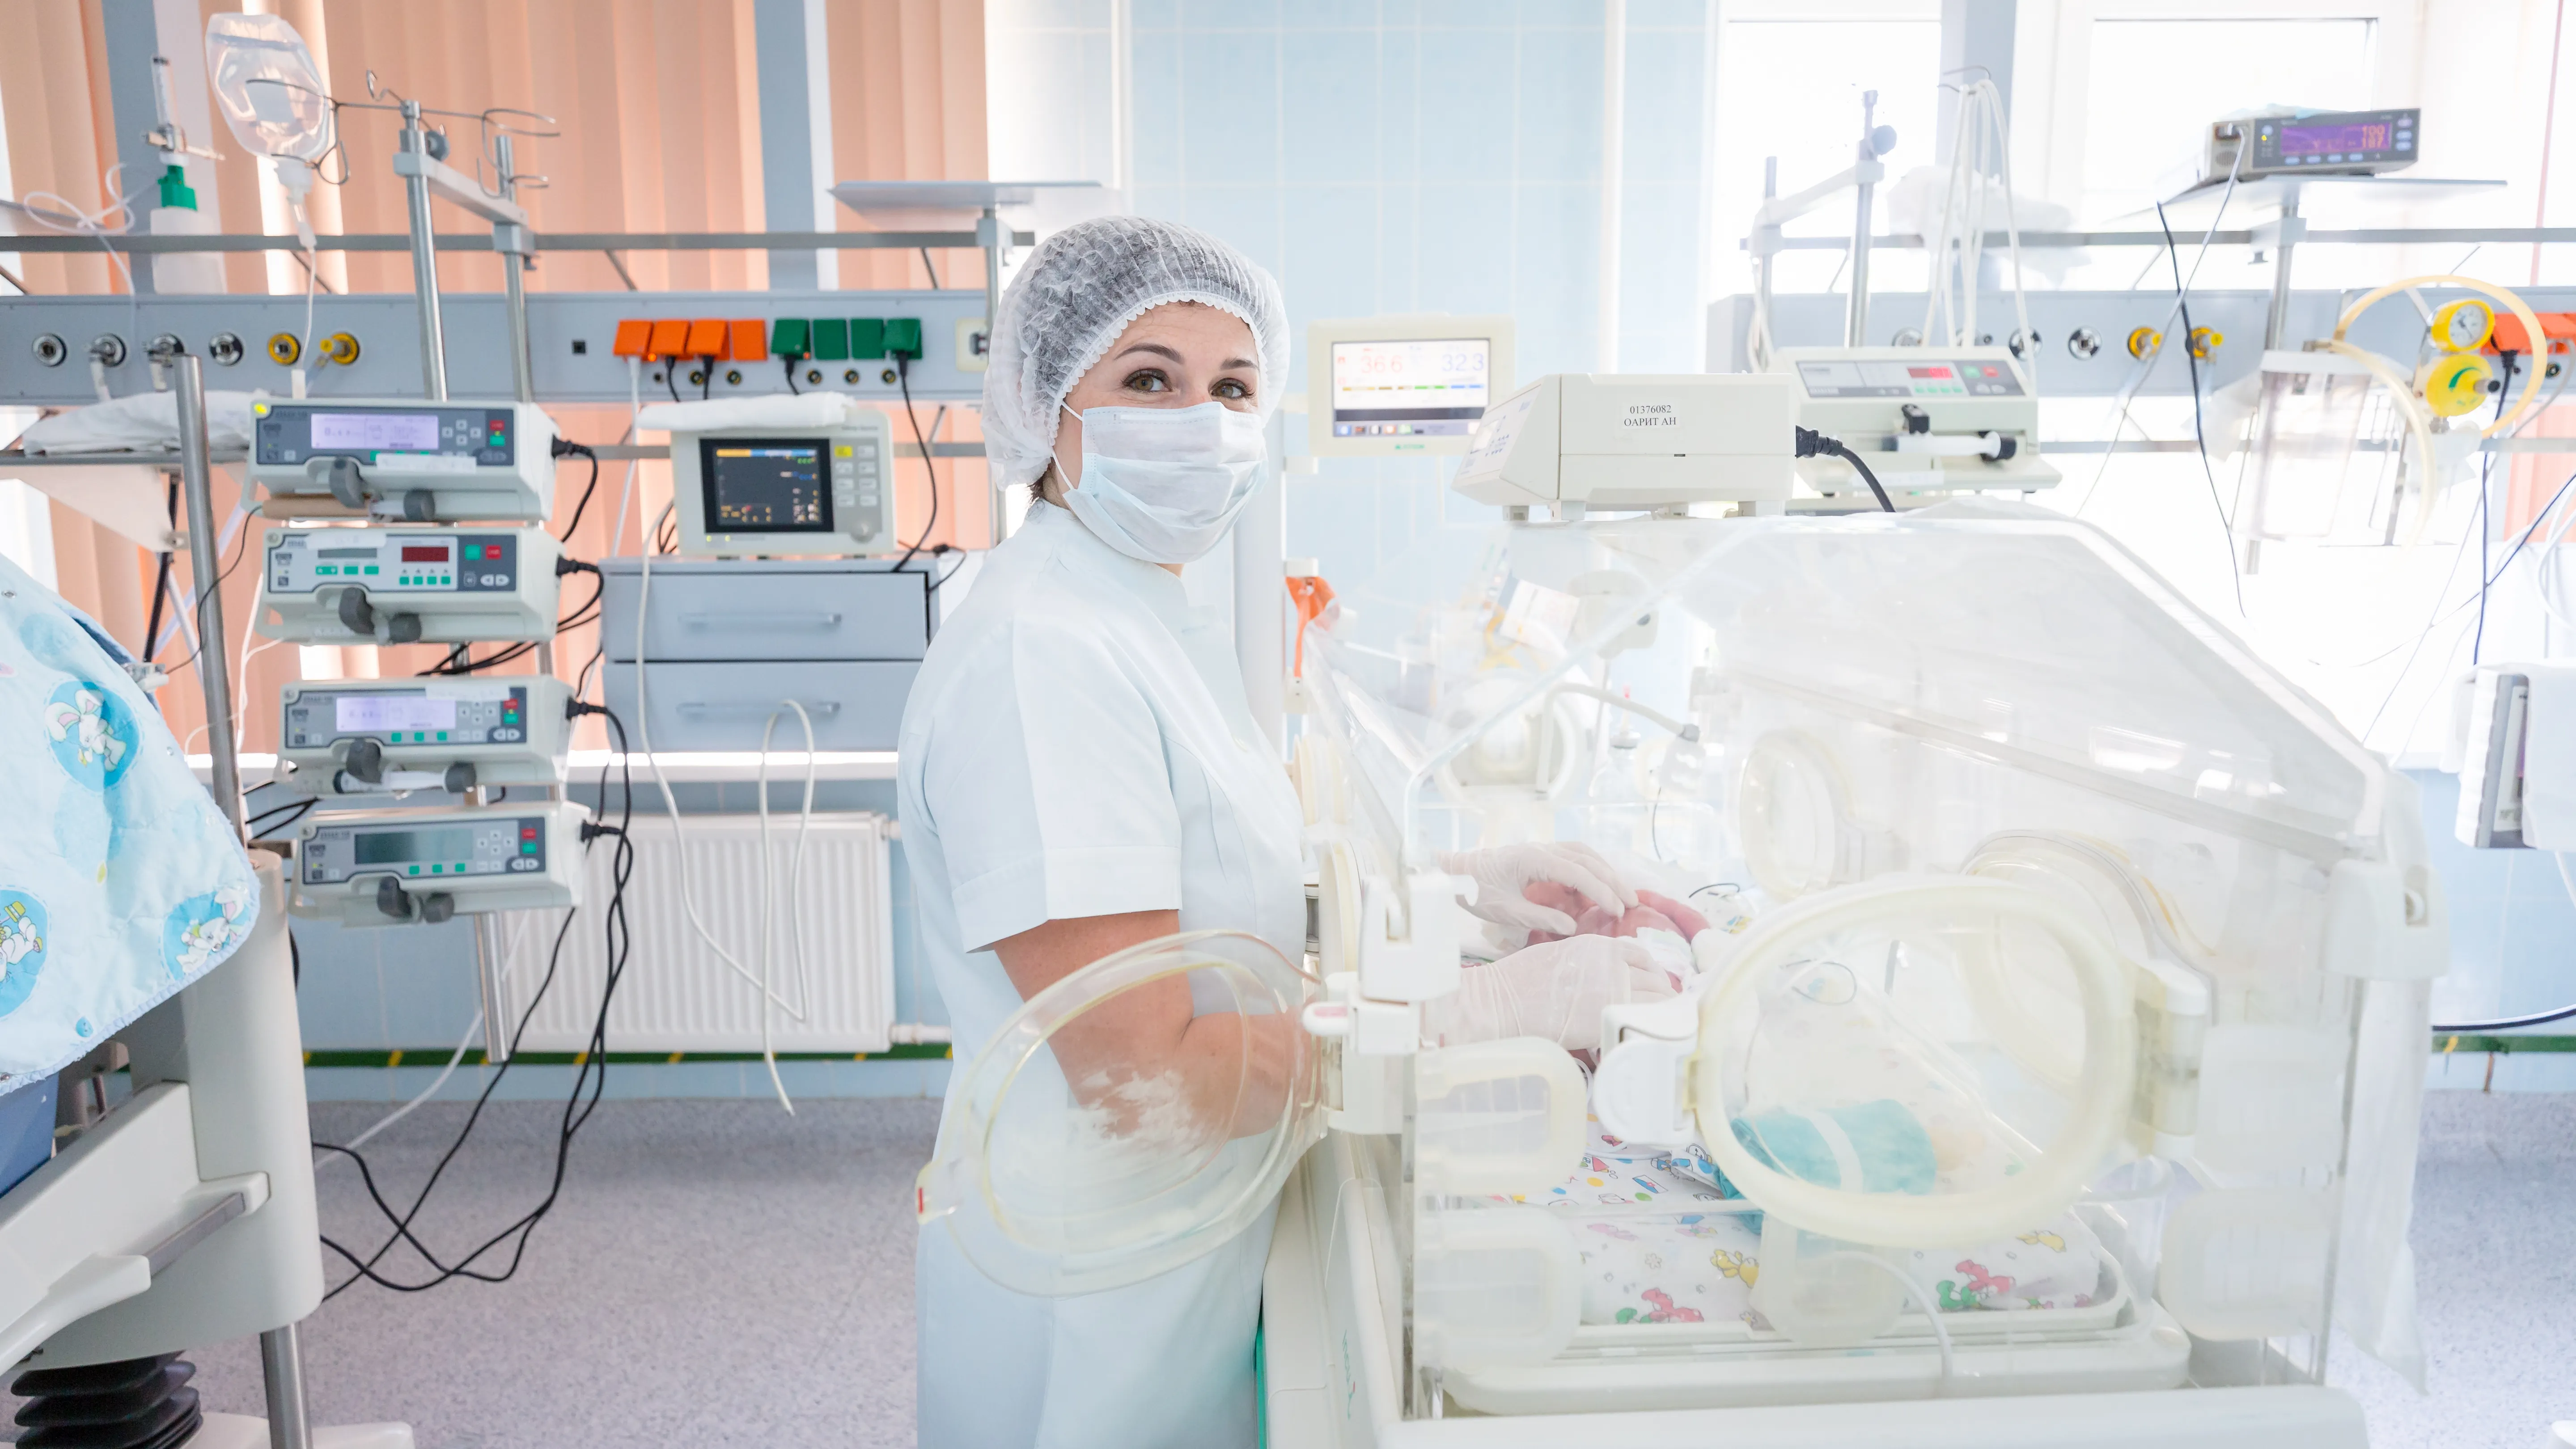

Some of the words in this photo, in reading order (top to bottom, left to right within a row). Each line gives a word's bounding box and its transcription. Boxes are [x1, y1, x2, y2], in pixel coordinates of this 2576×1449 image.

[1630, 405, 1671, 414] 01376082
[1624, 418, 1659, 426] ОАРИТ
[1661, 417, 1676, 425] АН
